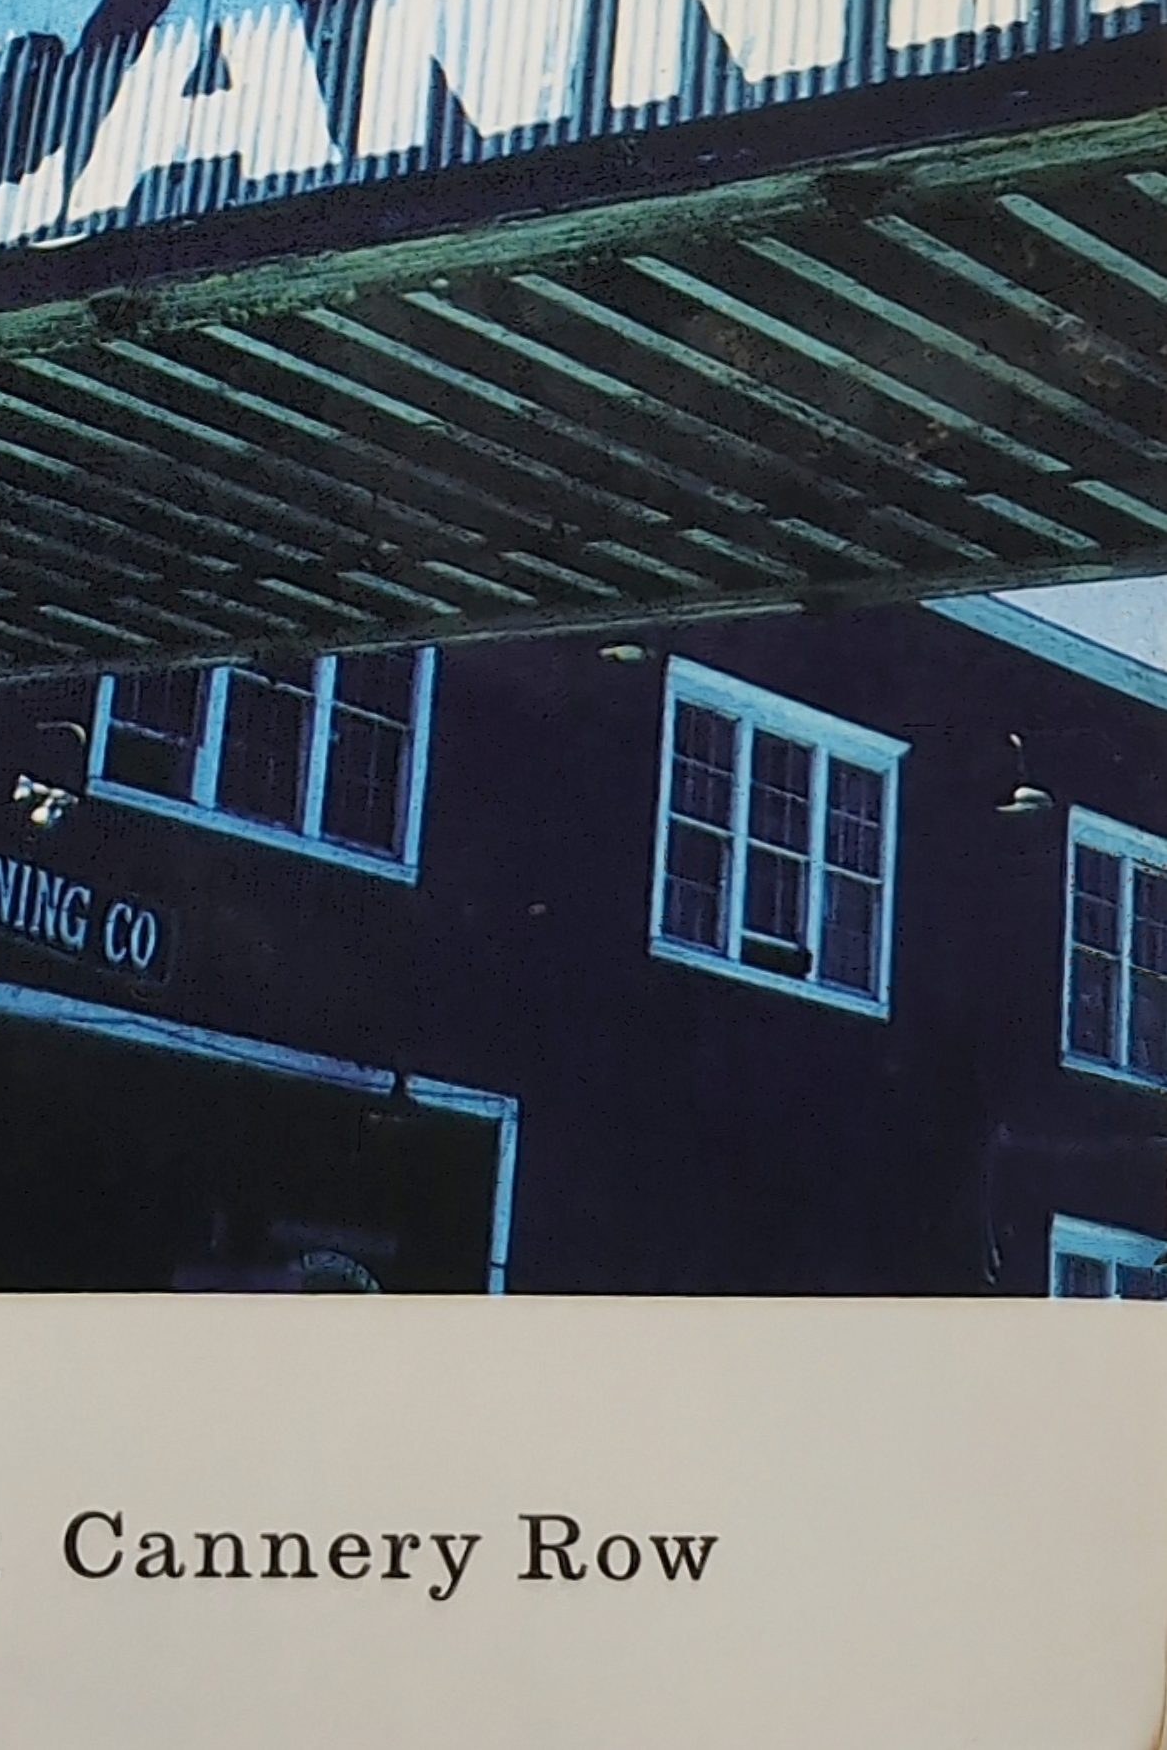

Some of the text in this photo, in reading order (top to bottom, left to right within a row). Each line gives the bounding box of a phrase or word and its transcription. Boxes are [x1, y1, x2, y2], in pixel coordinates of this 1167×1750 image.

[104, 900, 158, 970] CO
[62, 1511, 482, 1602] Cannery
[517, 1514, 720, 1582] Row
